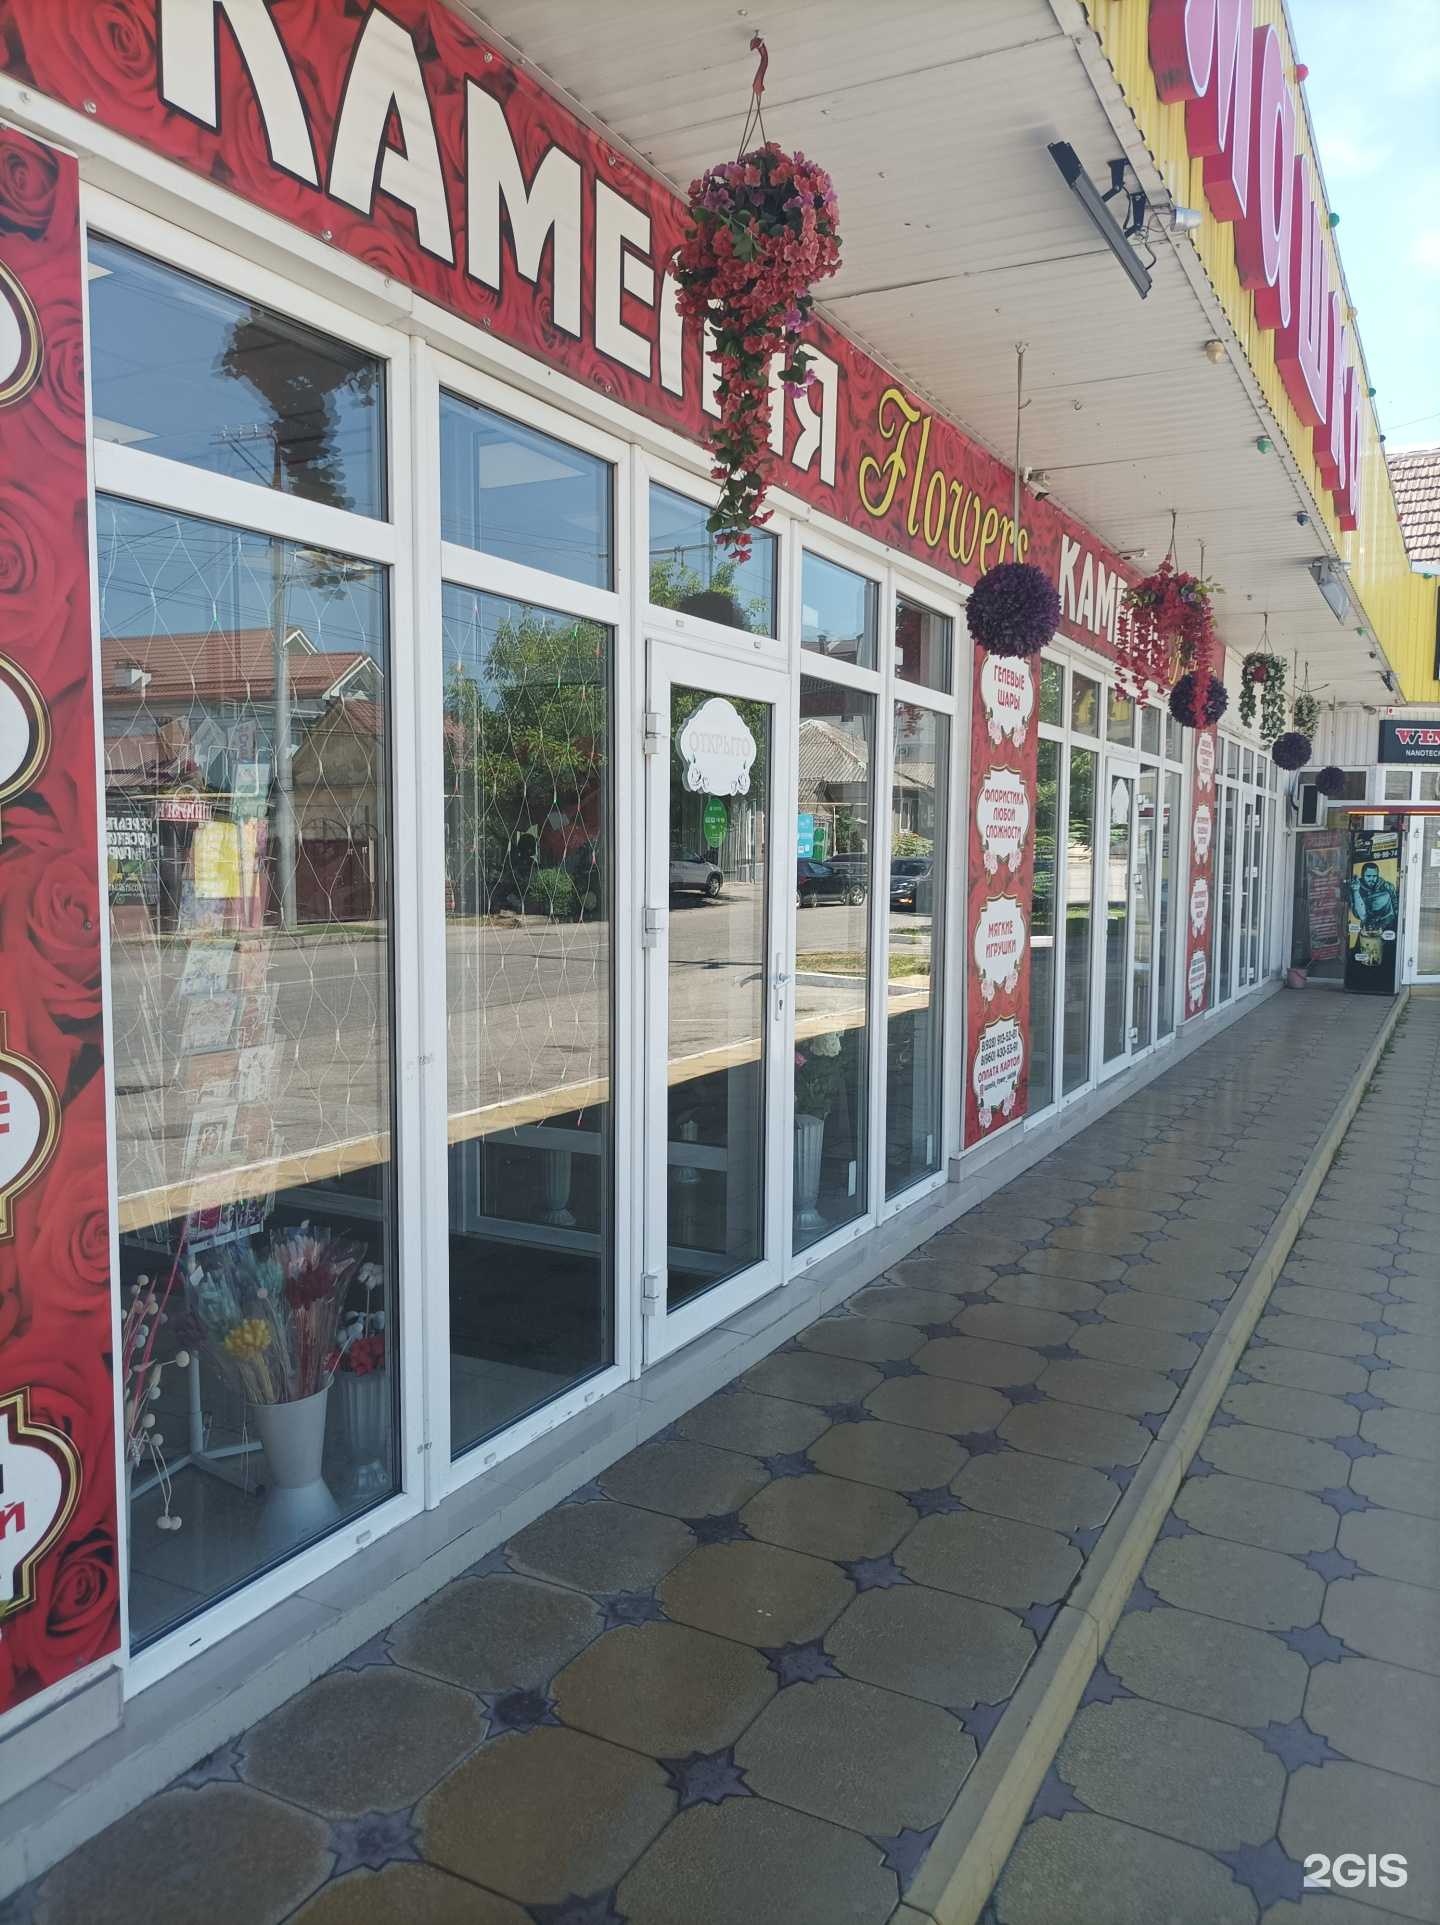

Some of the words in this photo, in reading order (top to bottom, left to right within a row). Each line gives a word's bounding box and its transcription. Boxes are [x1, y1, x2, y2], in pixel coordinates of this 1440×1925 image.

[993, 664, 1025, 690] ГЕЛЕВЫЕ
[997, 688, 1021, 710] ШАРЫ
[688, 731, 752, 757] ОТКРЫТО
[984, 788, 1024, 805] ФЛОРИСТИКА
[985, 824, 1022, 839] СЛОЖНОСТИ
[988, 920, 1013, 937] МЯГКИЕ
[985, 939, 1017, 958] ИГРУШКИ
